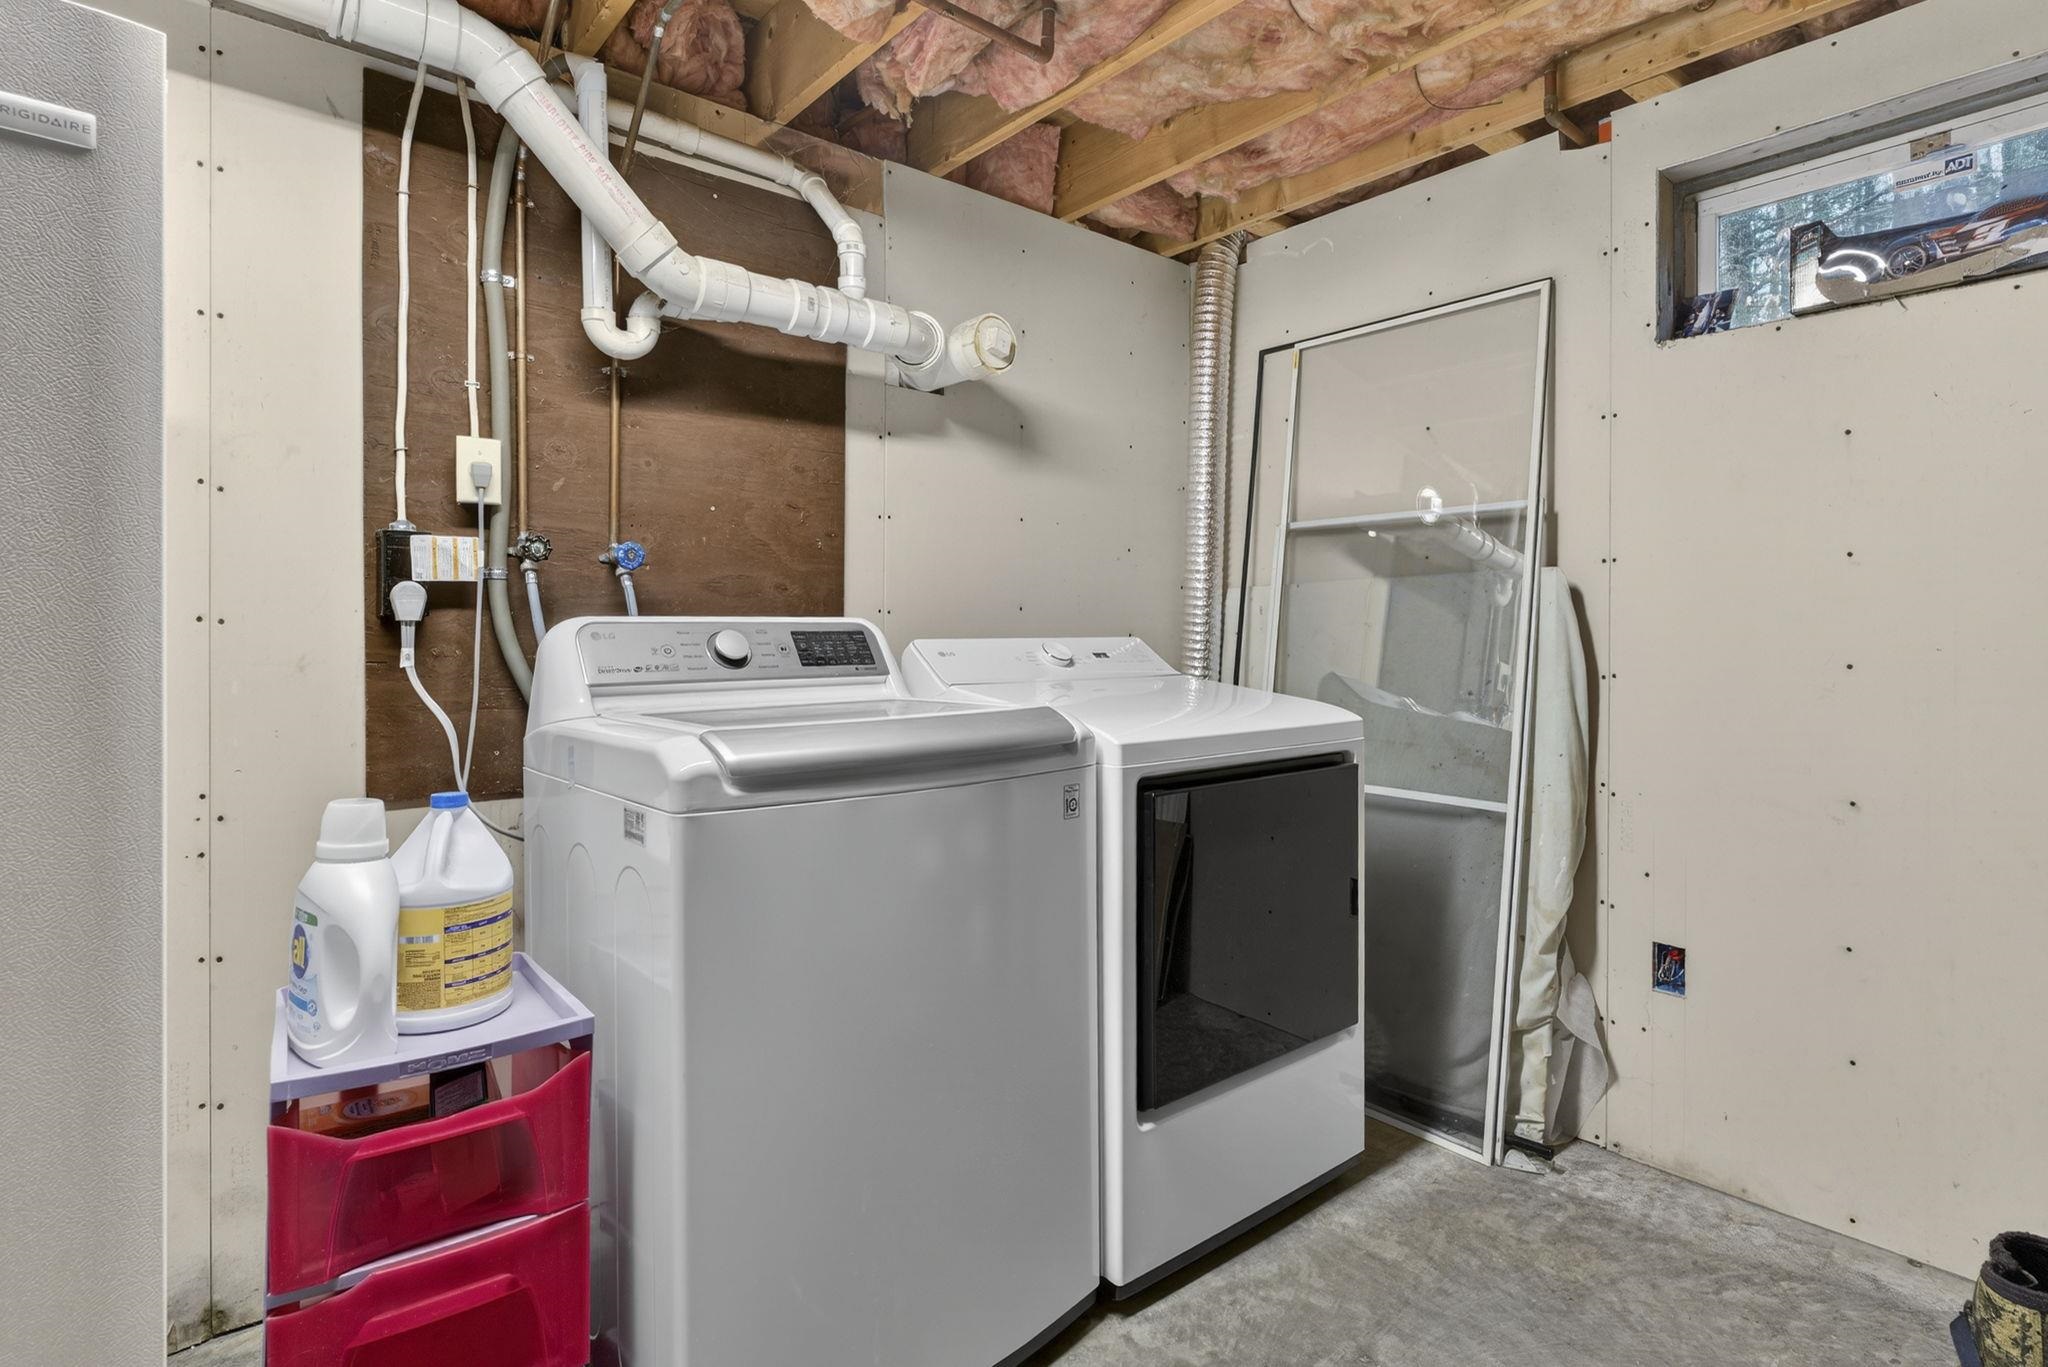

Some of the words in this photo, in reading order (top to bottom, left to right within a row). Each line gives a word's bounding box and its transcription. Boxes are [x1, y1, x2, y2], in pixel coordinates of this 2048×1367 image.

[0, 104, 91, 135] RIGIDAIRE
[1945, 156, 1973, 174] ADT
[292, 936, 306, 969] all
